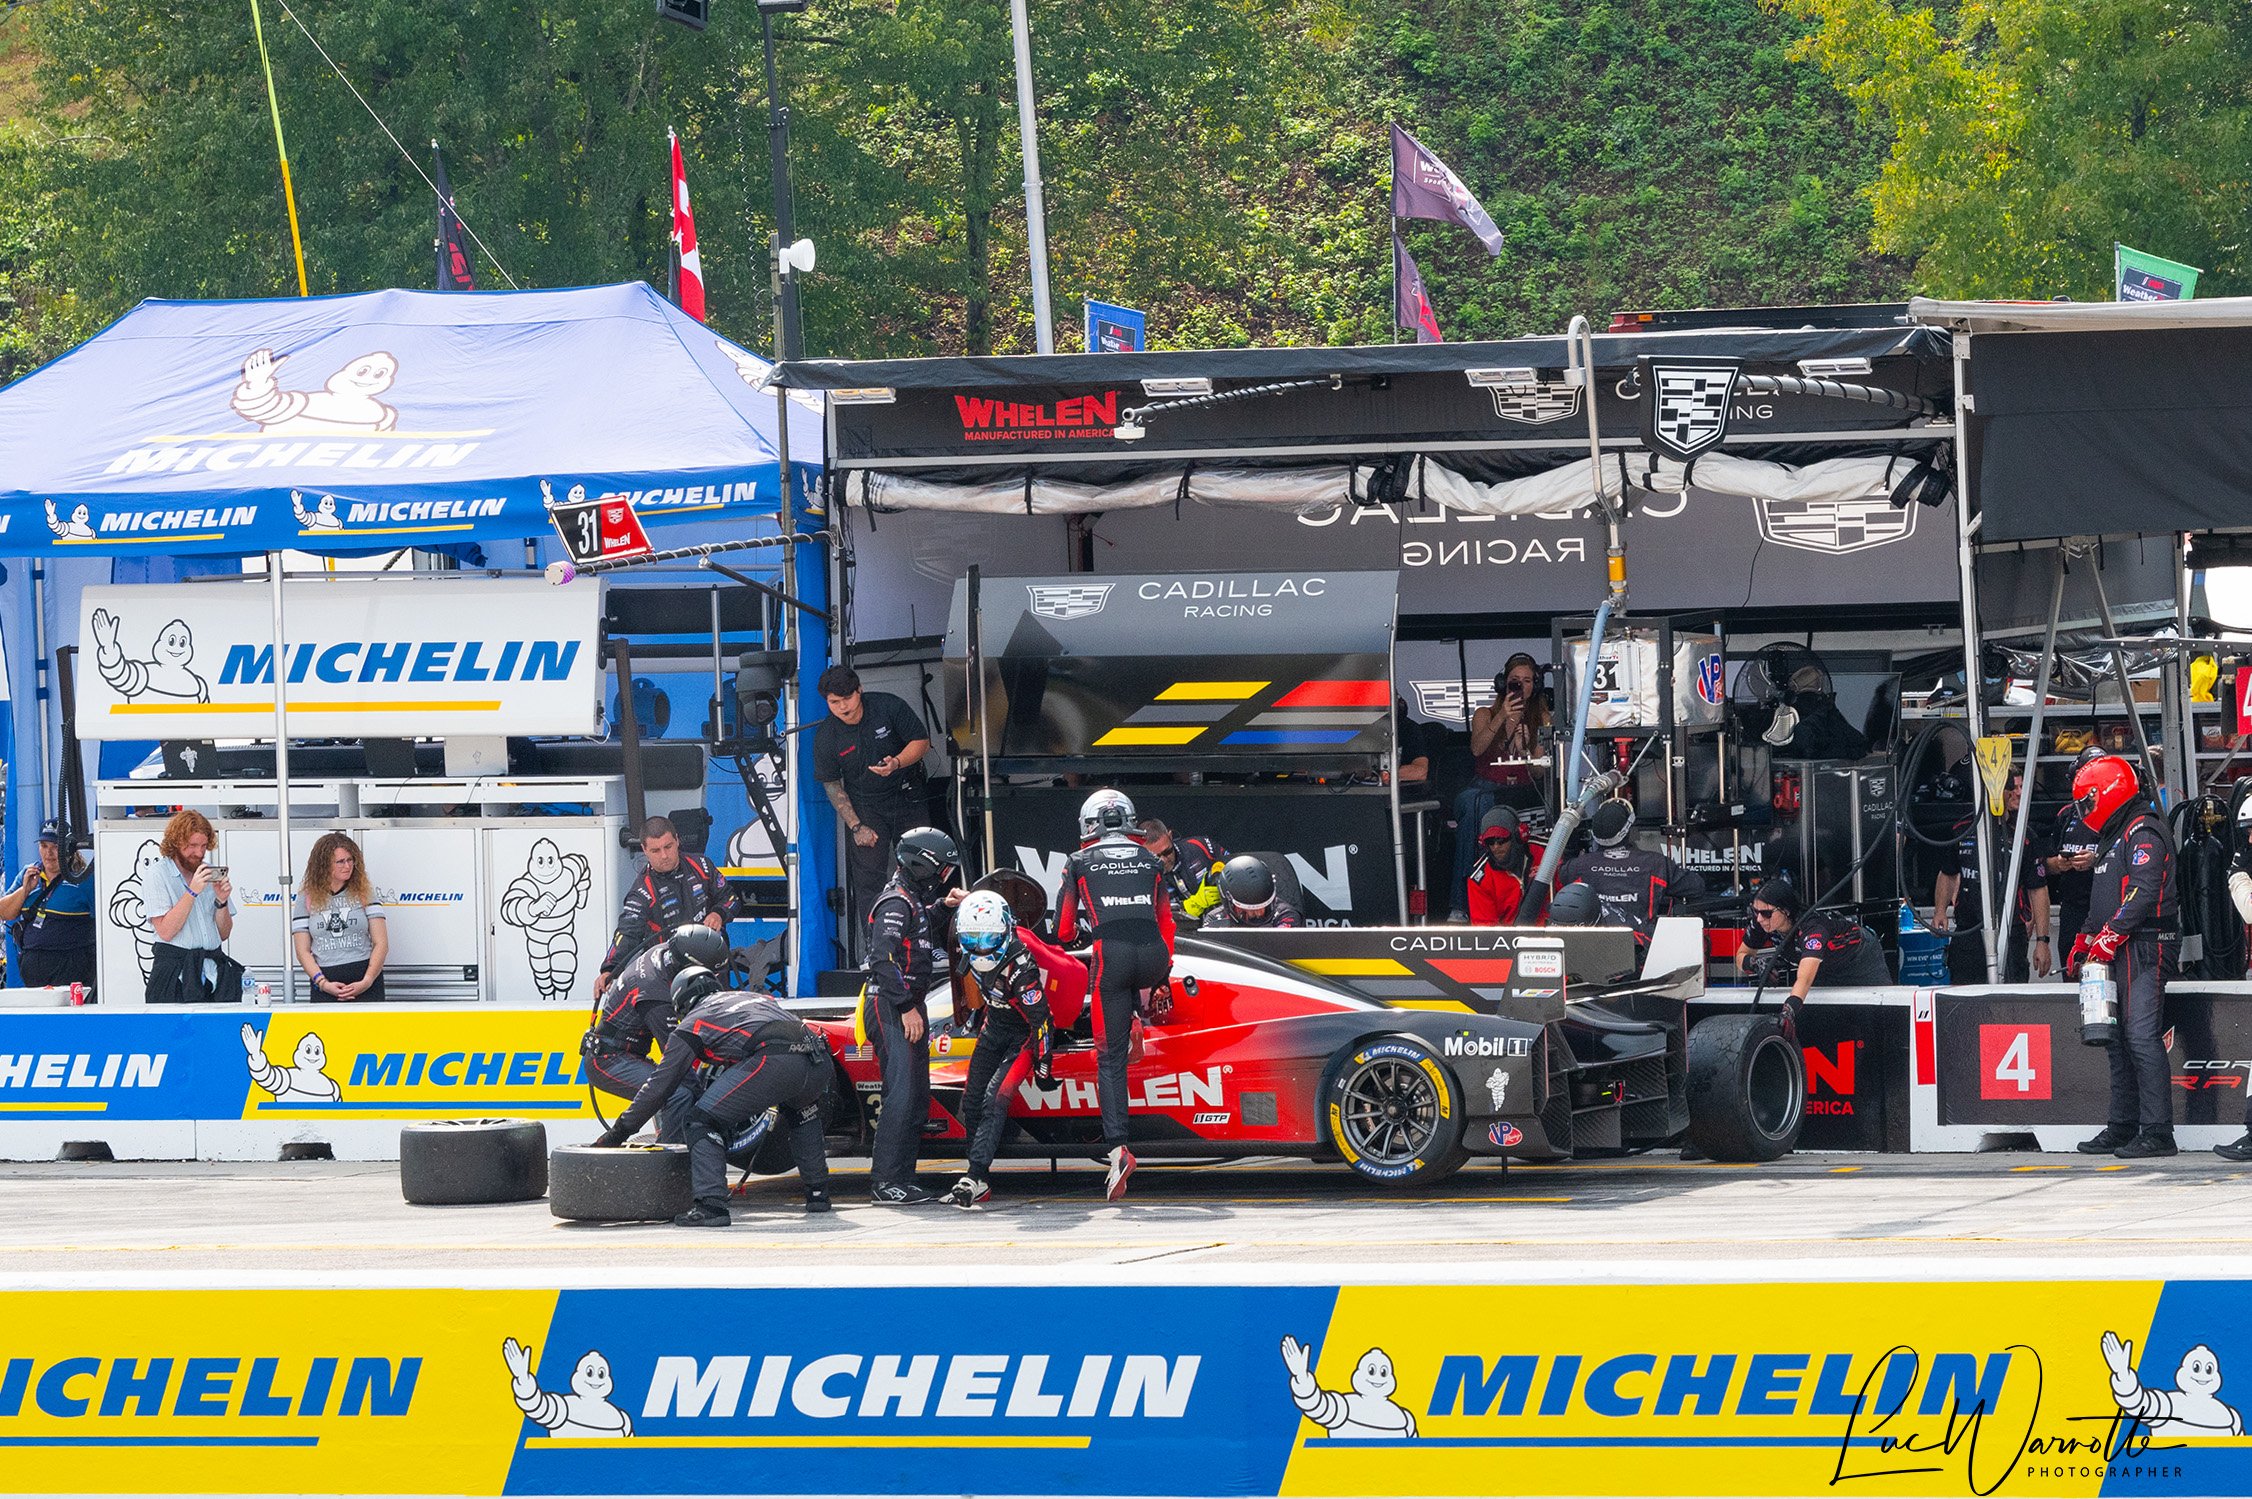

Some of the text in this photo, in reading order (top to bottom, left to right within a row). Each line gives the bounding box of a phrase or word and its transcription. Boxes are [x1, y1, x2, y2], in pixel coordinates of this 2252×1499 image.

[954, 391, 1116, 428] WHELEN
[1729, 404, 1774, 419] ING
[965, 428, 1115, 440] MANUFACTURED IN AMERICA
[102, 441, 482, 476] MICHELIN
[601, 482, 757, 508] ICHELIN
[100, 506, 257, 532] MICHELIN
[347, 498, 507, 523] MICHELIN
[577, 508, 599, 554] 31
[604, 532, 631, 548] WHELEN
[1138, 578, 1326, 600] CADILLAC
[1184, 604, 1273, 618] RACING
[218, 640, 582, 685] MICHELIN
[1863, 802, 1894, 813] CADILLAC
[1660, 842, 1763, 864] WHELEN
[1090, 861, 1151, 872] CADILLAC
[400, 892, 464, 902] MICHELIN
[1101, 894, 1152, 907] WHELEN
[1534, 966, 1556, 974] BOSCH
[938, 1039, 948, 1053] E
[1372, 1045, 1421, 1060] MICHELIN
[1444, 1036, 1504, 1056] Mobil
[1995, 1032, 2036, 1092] 4
[1018, 1065, 1225, 1111] WHEN
[1204, 1114, 1228, 1122] GTP
[0, 1357, 422, 1418] ICHELIN
[640, 1355, 1202, 1419] MICHELIN
[1428, 1353, 2012, 1417] MICHELIN
